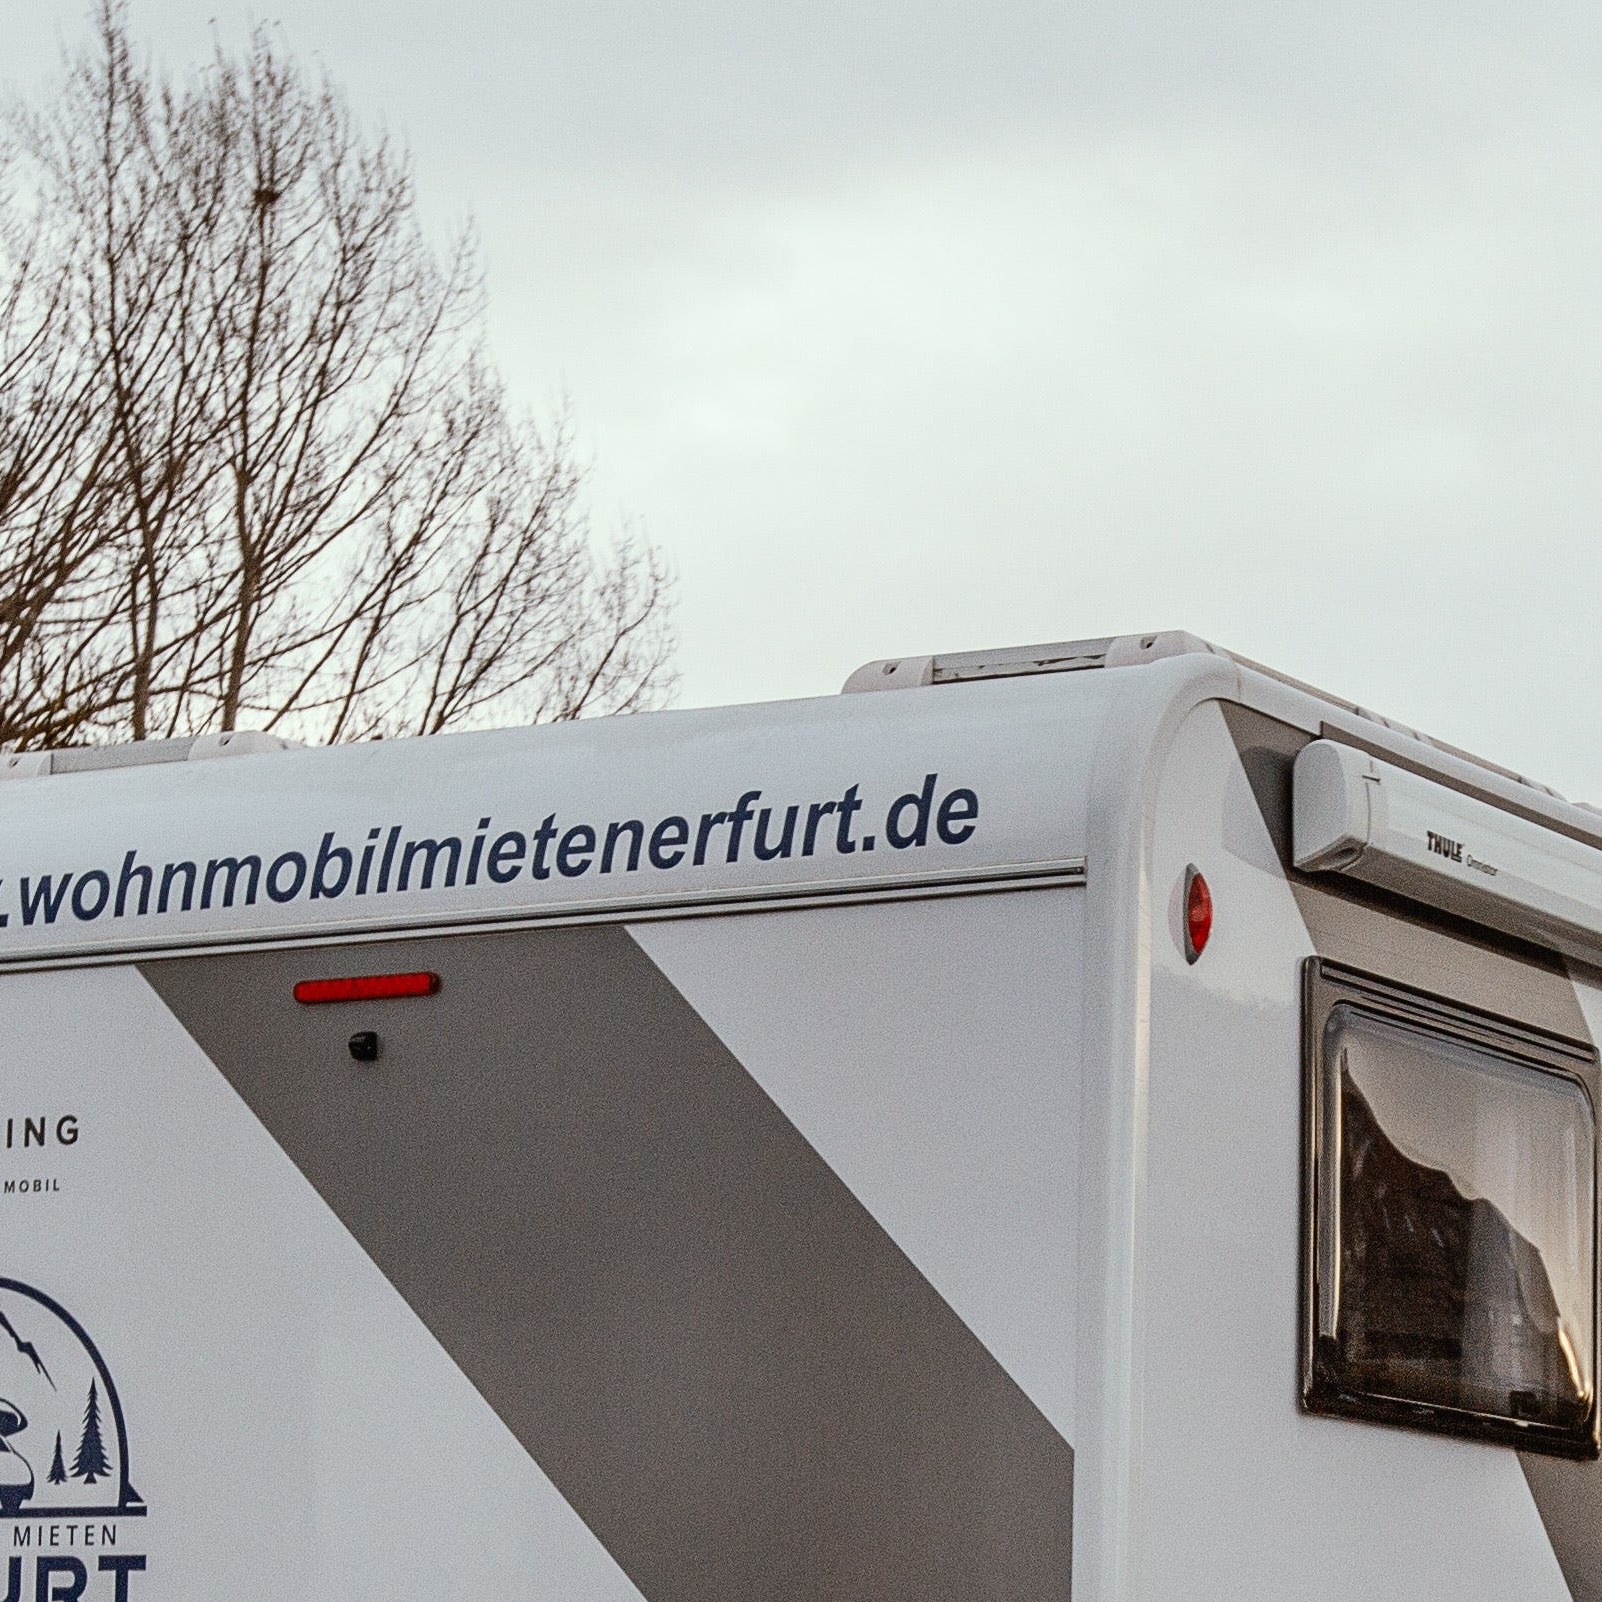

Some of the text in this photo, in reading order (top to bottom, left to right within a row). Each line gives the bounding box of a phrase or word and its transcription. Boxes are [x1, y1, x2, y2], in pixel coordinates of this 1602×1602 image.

[1427, 830, 1463, 864] THULE
[3, 1178, 60, 1193] MOBIL
[13, 1524, 117, 1546] MIETEN
